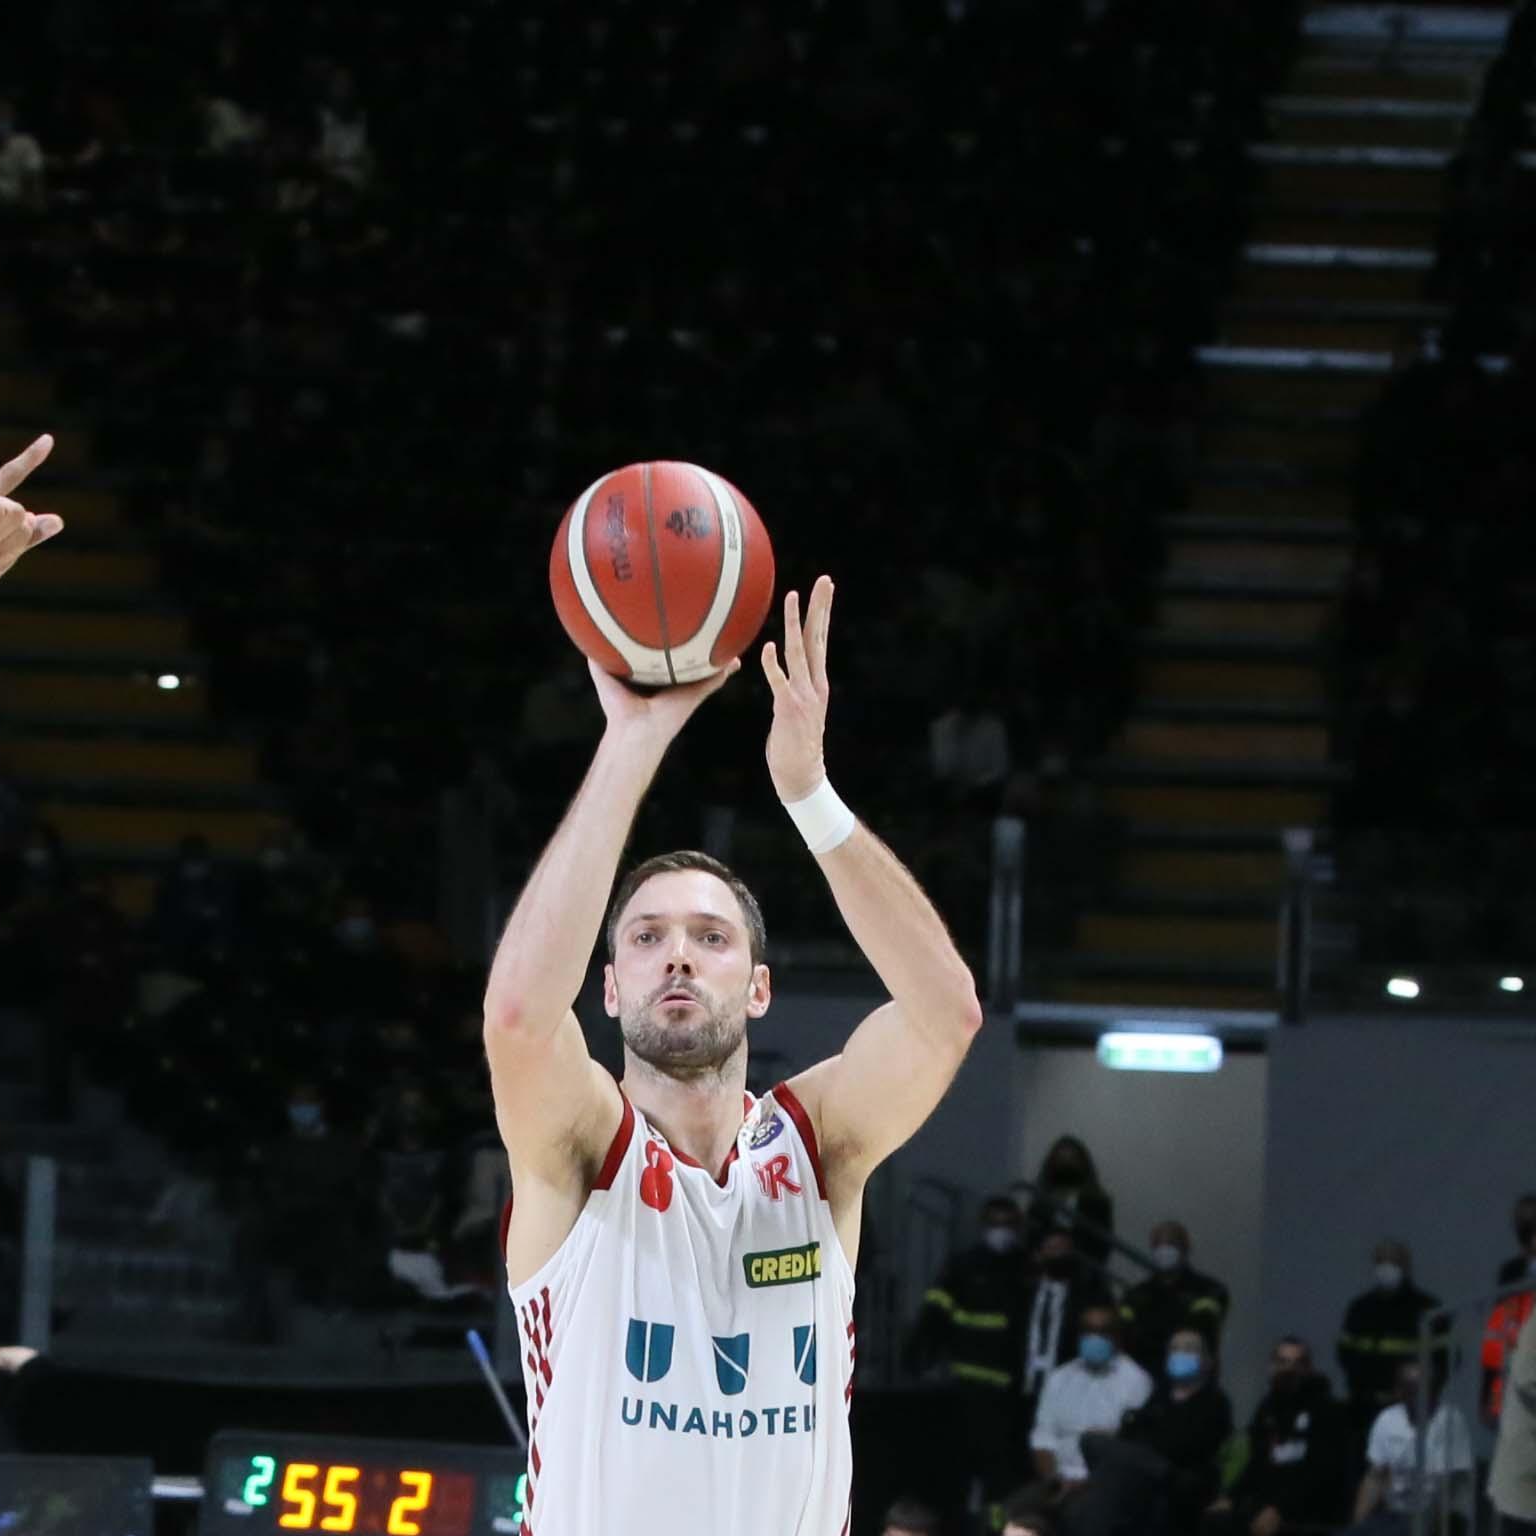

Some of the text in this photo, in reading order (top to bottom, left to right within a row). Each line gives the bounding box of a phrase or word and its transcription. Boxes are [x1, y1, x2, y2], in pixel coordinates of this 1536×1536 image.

[243, 1456, 276, 1506] 2
[279, 1463, 360, 1532] 55
[387, 1470, 432, 1536] 2
